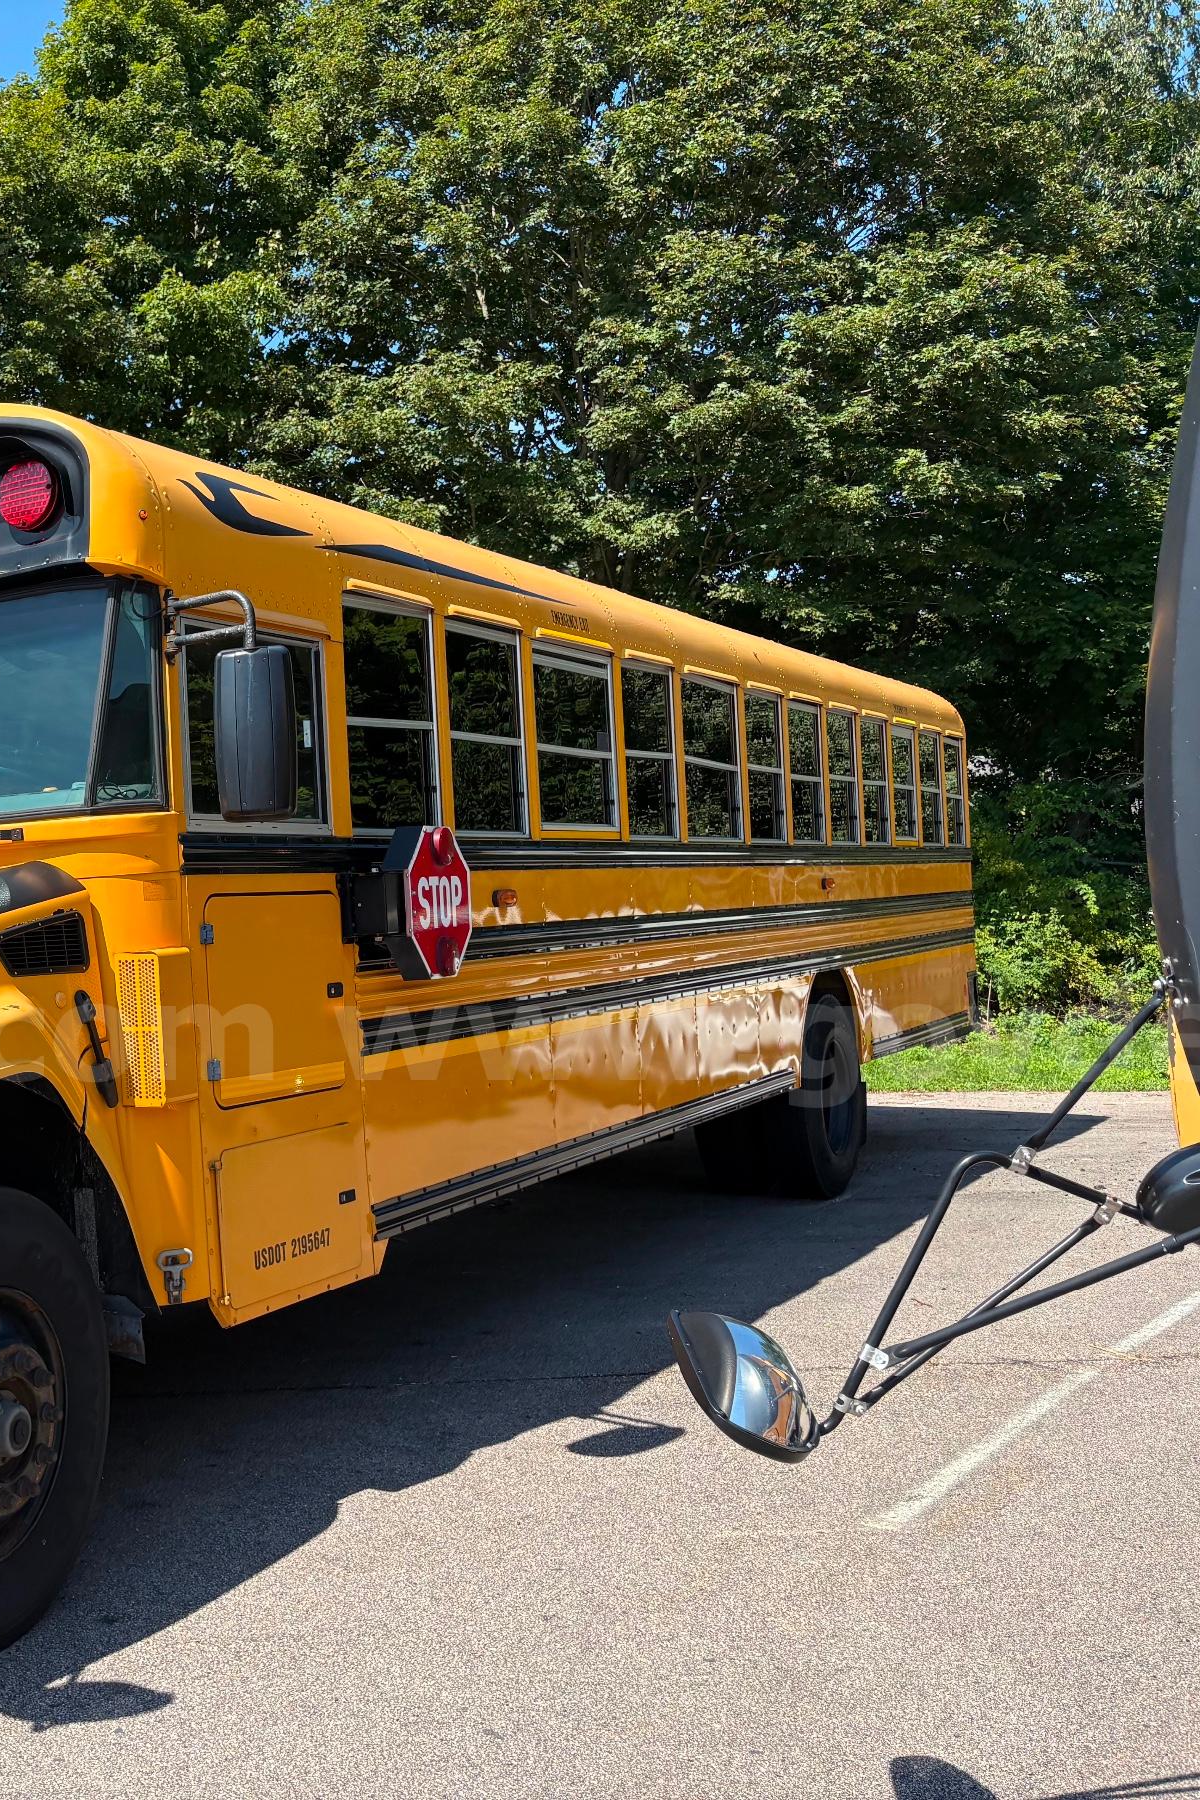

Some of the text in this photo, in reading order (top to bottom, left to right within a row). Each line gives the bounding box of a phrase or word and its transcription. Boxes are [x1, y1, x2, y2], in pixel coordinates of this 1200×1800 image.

[417, 875, 463, 930] STOP
[254, 1227, 331, 1271] USDOT 2195647
